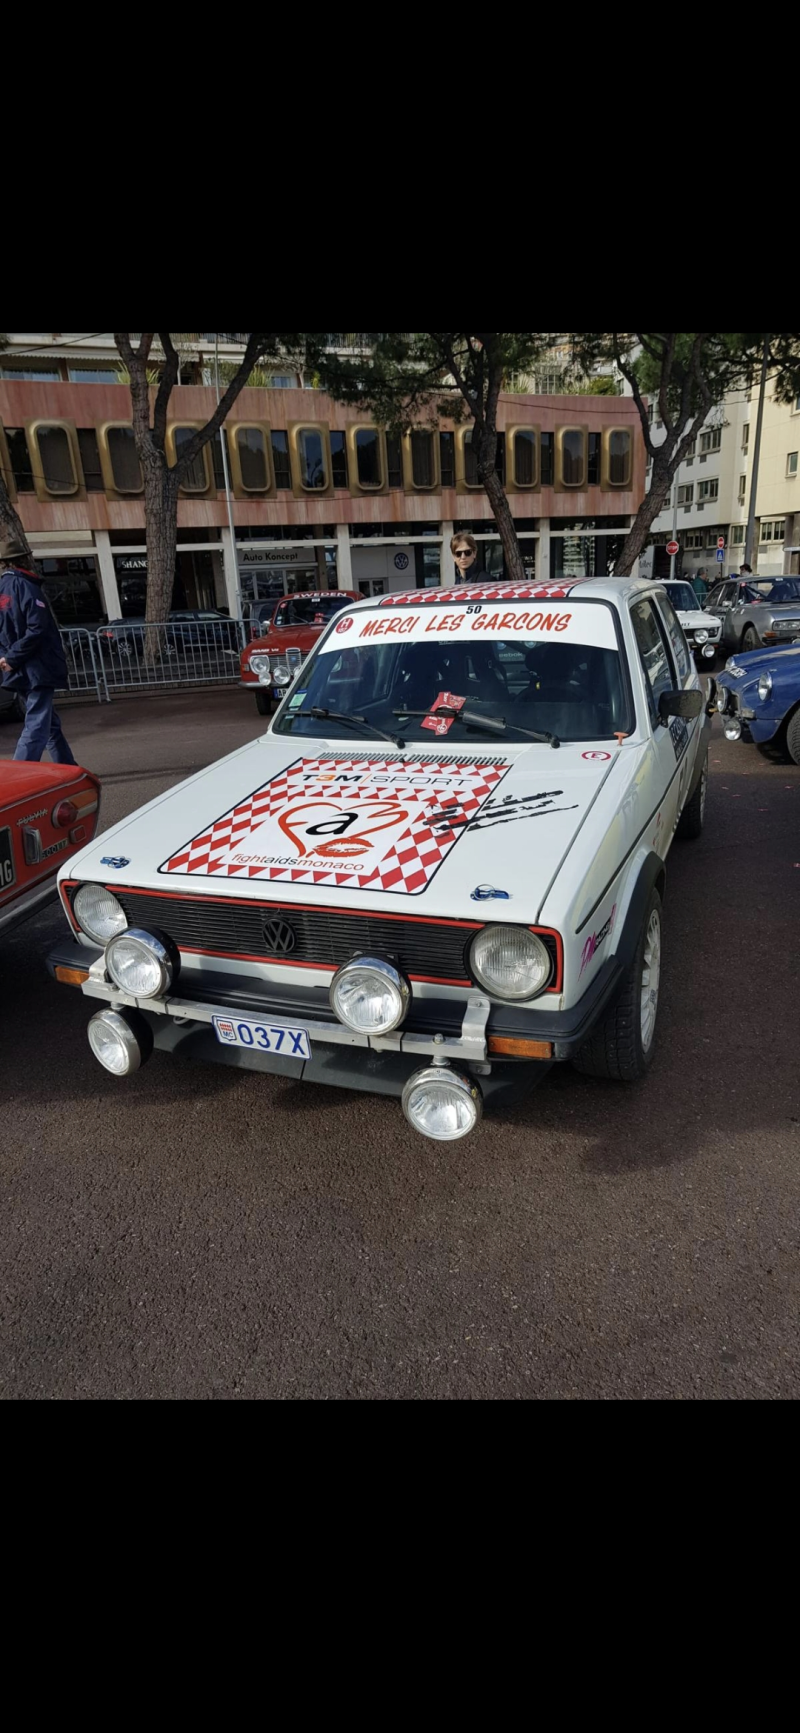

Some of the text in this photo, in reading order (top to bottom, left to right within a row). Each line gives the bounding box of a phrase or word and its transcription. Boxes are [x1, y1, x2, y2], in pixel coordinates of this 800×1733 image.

[243, 552, 299, 562] Auto Koncept
[465, 605, 482, 615] 50
[358, 612, 573, 638] MERCI LES GARCONS
[302, 774, 473, 786] T3M SPORT
[231, 853, 365, 871] fightaidsmonaco
[237, 1023, 306, 1056] 037X
